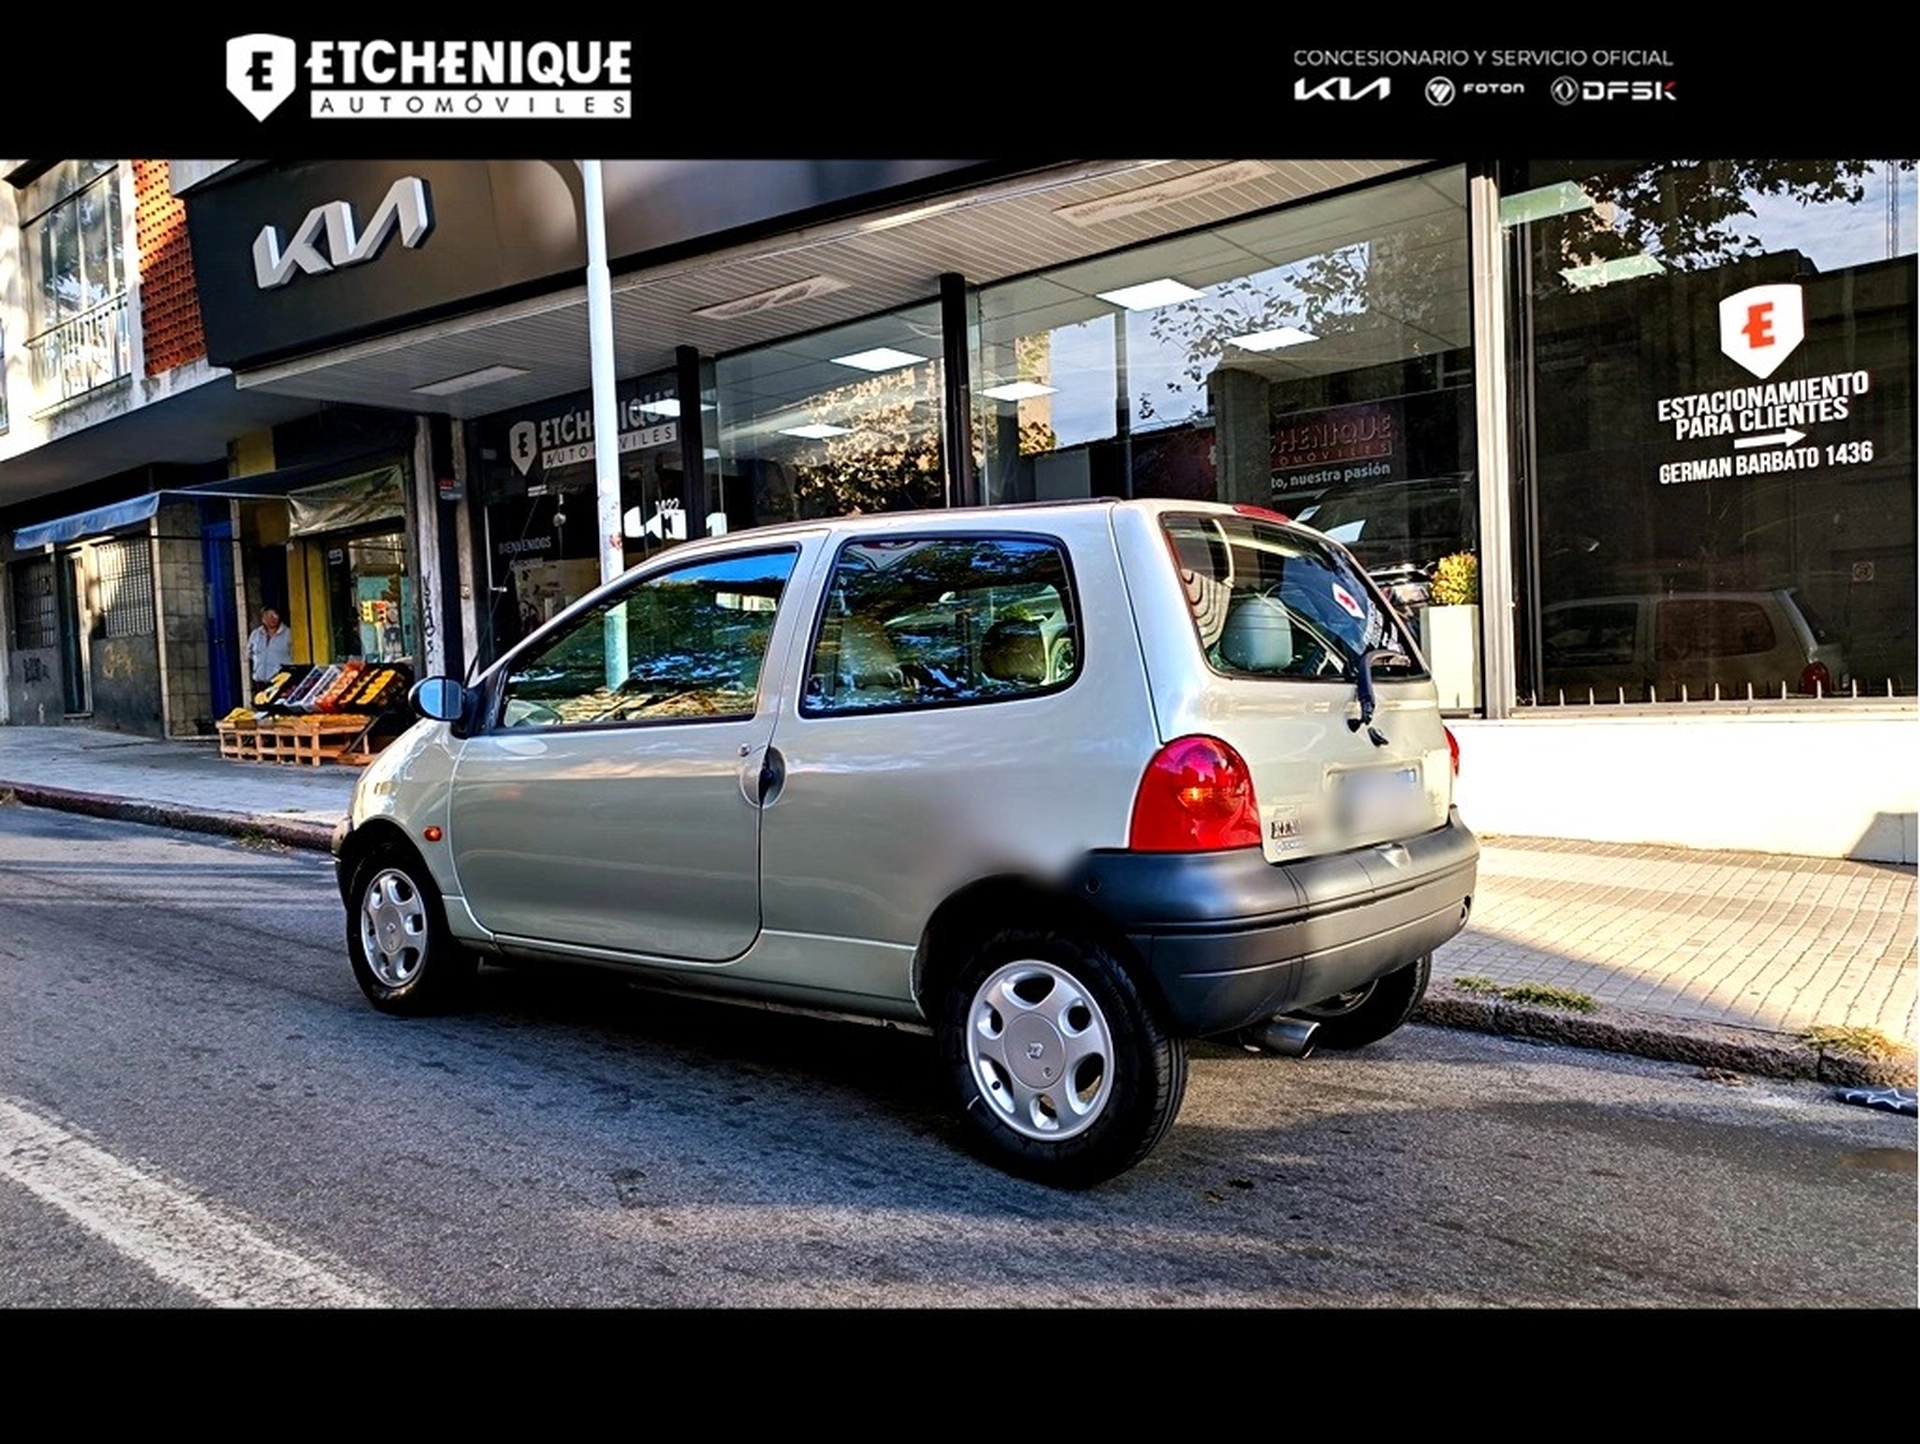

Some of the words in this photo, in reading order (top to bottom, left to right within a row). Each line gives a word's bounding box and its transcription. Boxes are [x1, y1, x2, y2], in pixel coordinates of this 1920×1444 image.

[252, 175, 429, 289] KIA
[1658, 370, 1868, 422] ESTACIONAMIENTO
[539, 389, 676, 448] ETCHIQU
[1675, 416, 1734, 440] PARA
[1740, 397, 1849, 431] CLIENTES
[545, 427, 673, 467] AUTOVILES
[1659, 457, 1732, 484] GERMAN
[1736, 447, 1820, 475] BARBATO
[1826, 441, 1874, 465] 1436
[1290, 470, 1341, 486] nuestra
[1344, 461, 1391, 482] pasión
